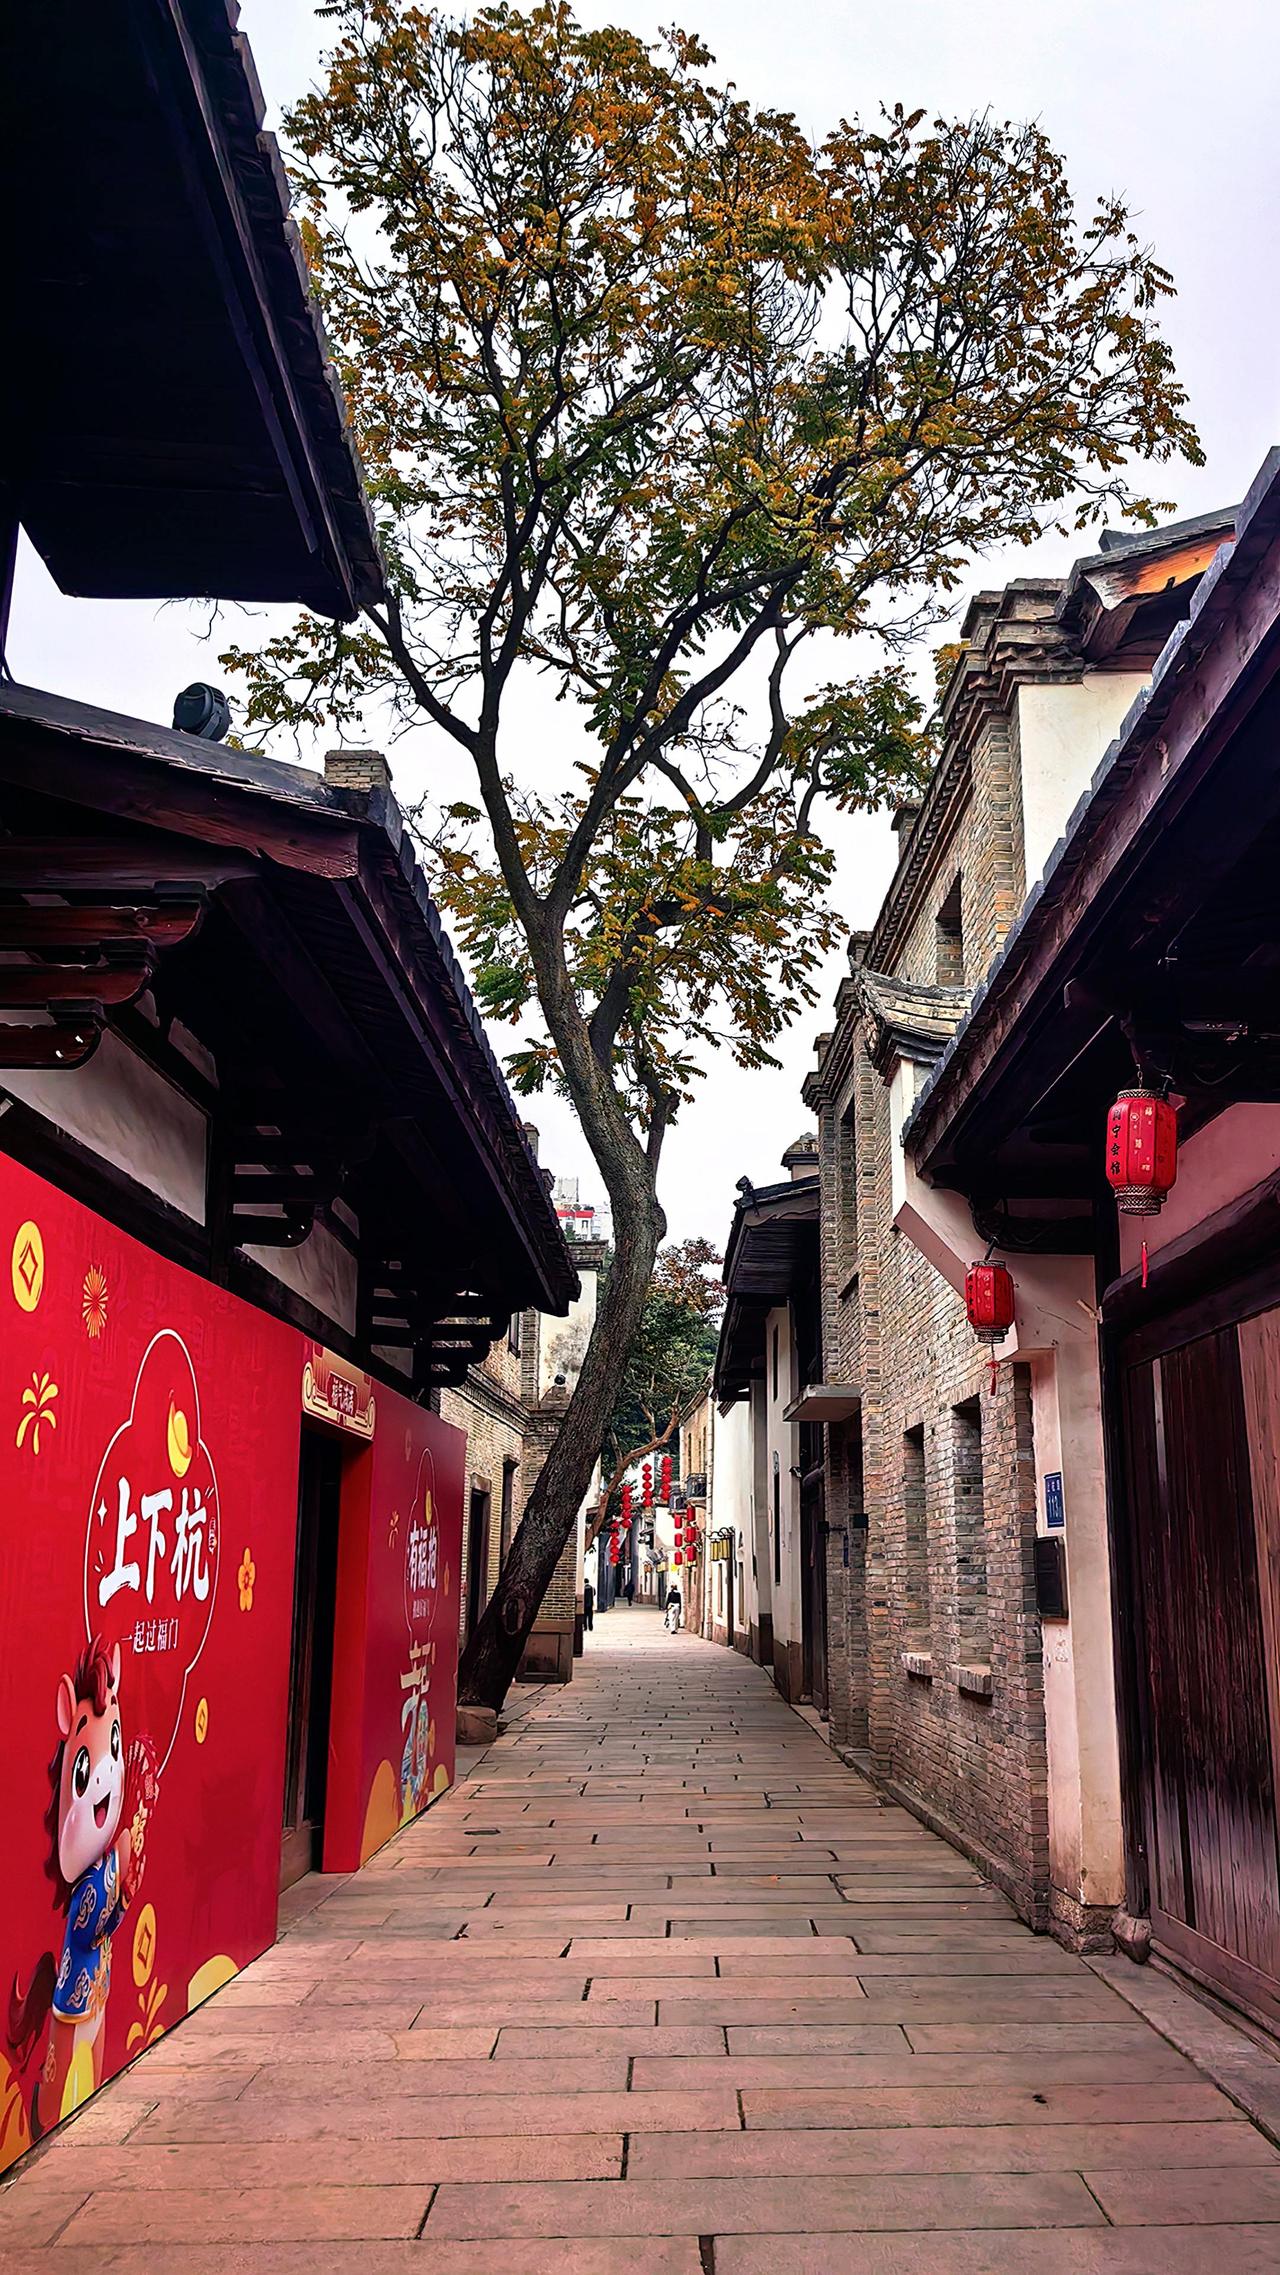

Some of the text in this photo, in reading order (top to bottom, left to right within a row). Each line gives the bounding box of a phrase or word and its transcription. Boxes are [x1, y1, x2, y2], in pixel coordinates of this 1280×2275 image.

[99, 1476, 210, 1607] 上下杭
[121, 1618, 179, 1654] 一起过福门
